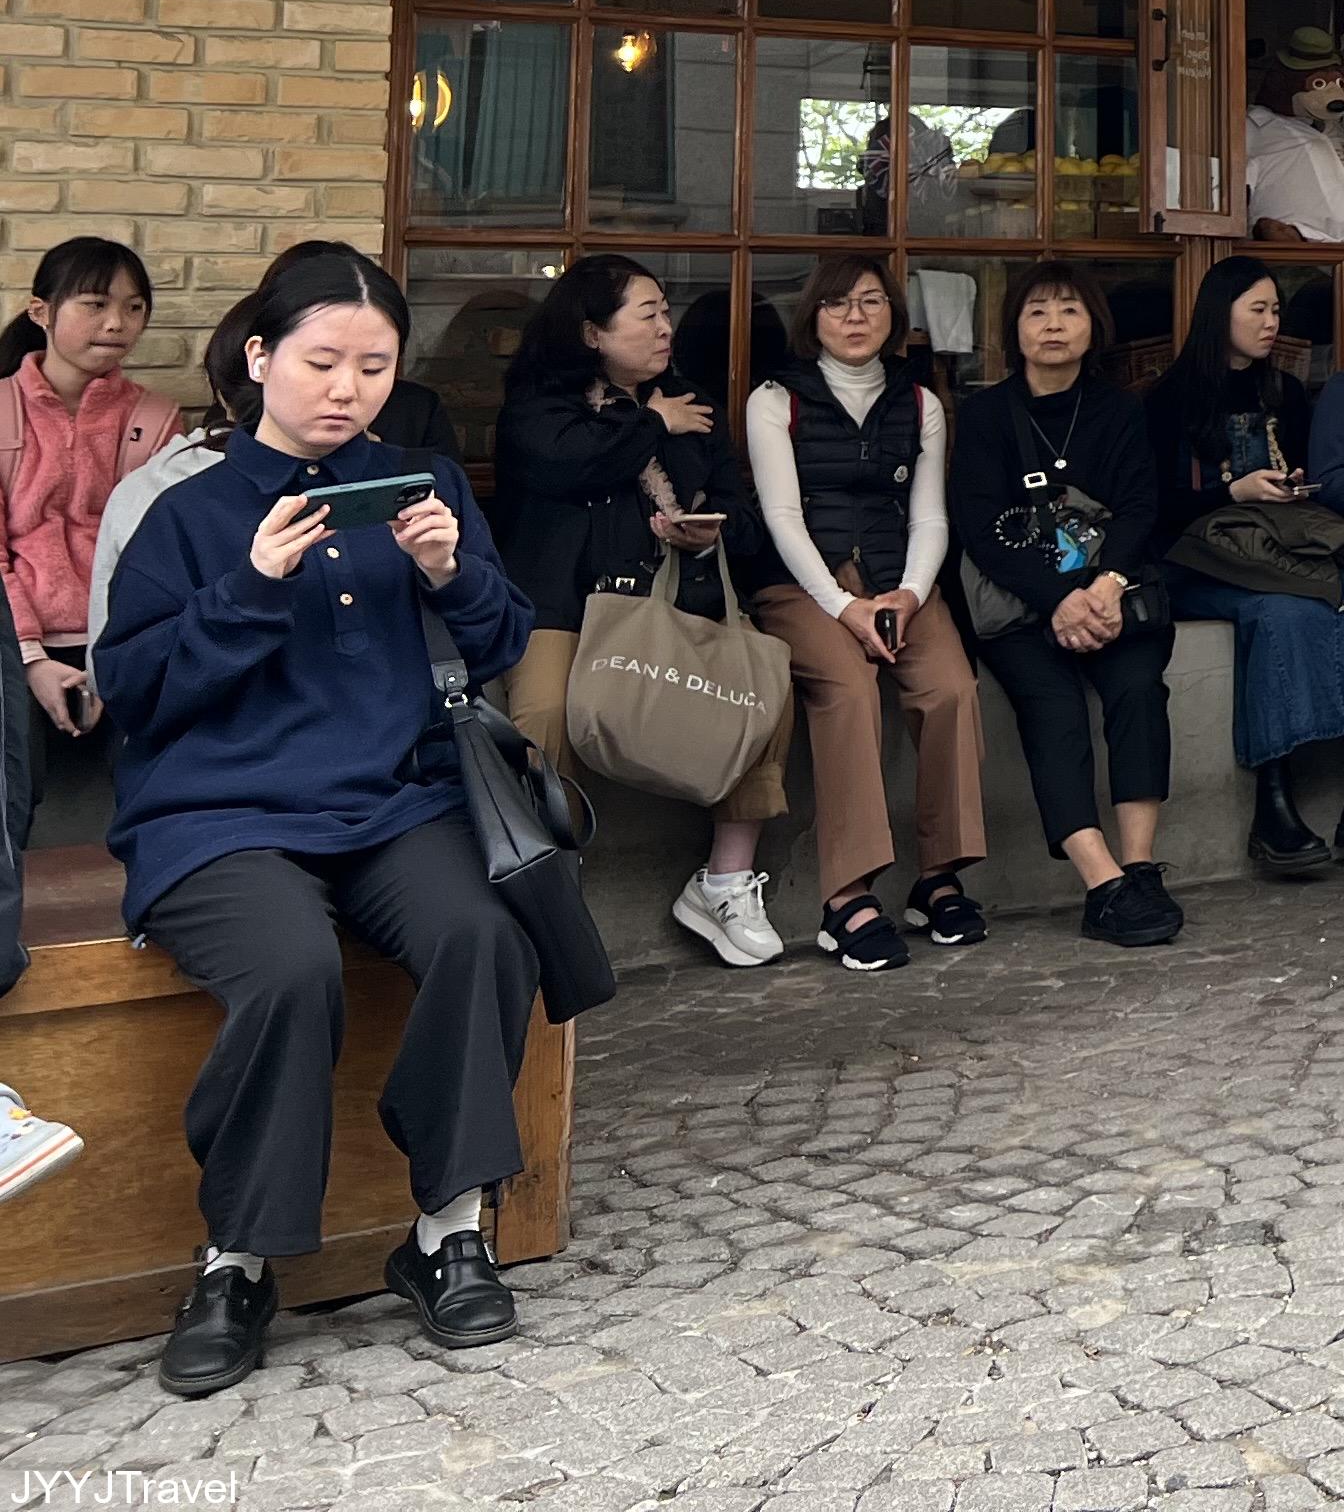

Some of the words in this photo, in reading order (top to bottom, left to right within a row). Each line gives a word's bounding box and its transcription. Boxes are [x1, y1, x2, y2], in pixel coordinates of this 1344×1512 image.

[591, 654, 661, 683] DEAN
[665, 666, 682, 685] &
[686, 673, 768, 716] DELUCA
